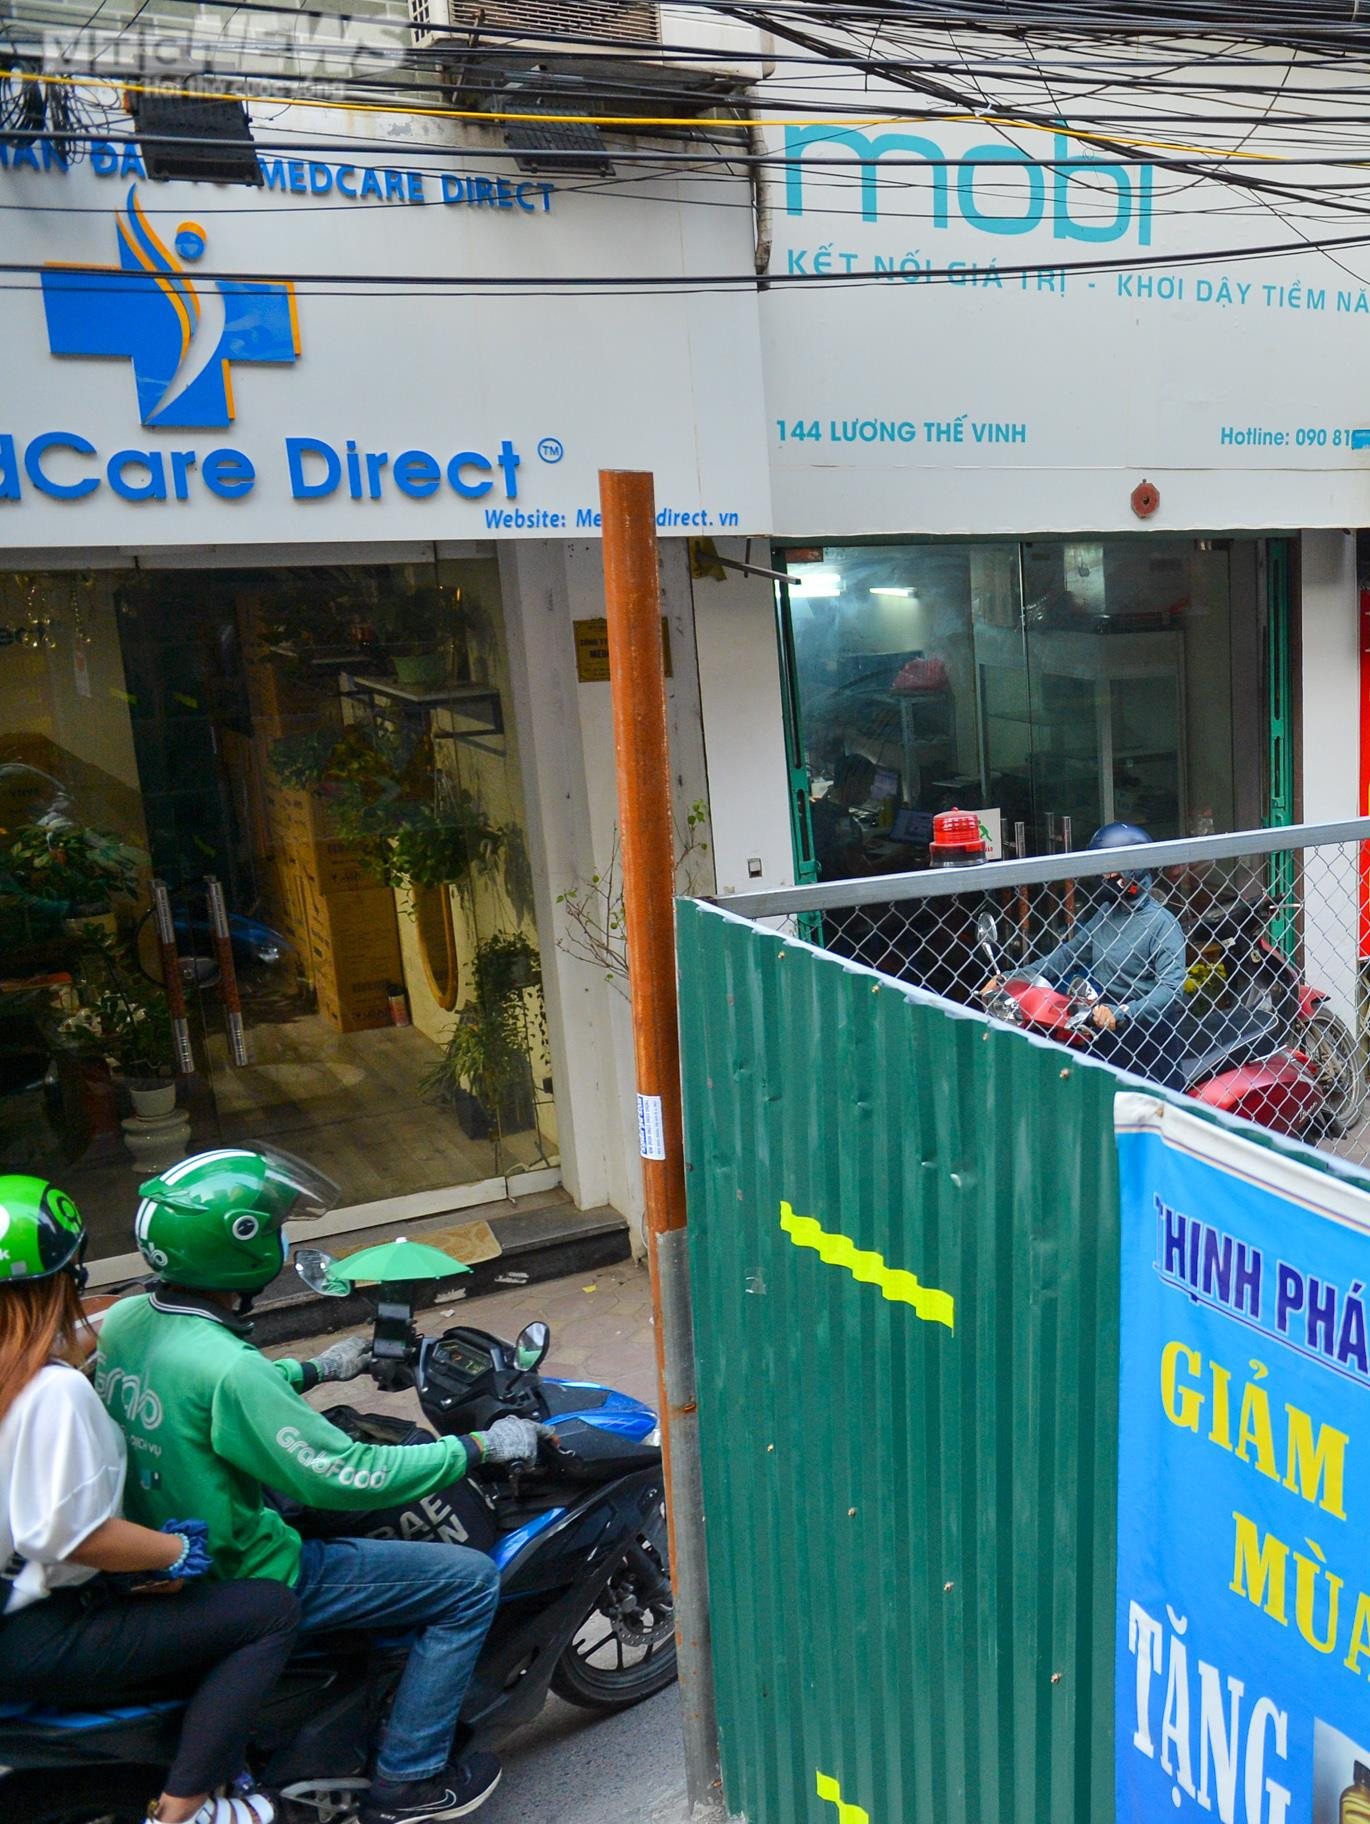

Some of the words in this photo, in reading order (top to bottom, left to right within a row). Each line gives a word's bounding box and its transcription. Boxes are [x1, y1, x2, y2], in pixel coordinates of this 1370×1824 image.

[258, 157, 424, 203] MEDCARE
[441, 173, 555, 212] DIRECT
[785, 120, 1152, 247] mobi
[787, 243, 858, 278] KẾT
[874, 249, 931, 284] NỐI
[946, 257, 1003, 288] GIÁ
[1196, 276, 1251, 308] DẬY
[1262, 280, 1326, 310] TIỀM
[776, 420, 822, 441] 144
[830, 417, 916, 442] LƯƠNG
[923, 414, 968, 442] THẾ
[971, 423, 1026, 443] VINH
[1220, 426, 1290, 446] Hotline:
[1295, 428, 1327, 446] 090
[1332, 429, 1354, 447] 81
[285, 437, 520, 500] Direct
[485, 508, 566, 529] Website:
[576, 508, 712, 529] Medirect.
[719, 512, 739, 527] vn
[275, 1426, 388, 1489] GrabFood
[1160, 1340, 1349, 1521] GIẢM
[1128, 1599, 1292, 1824] TẶNG
